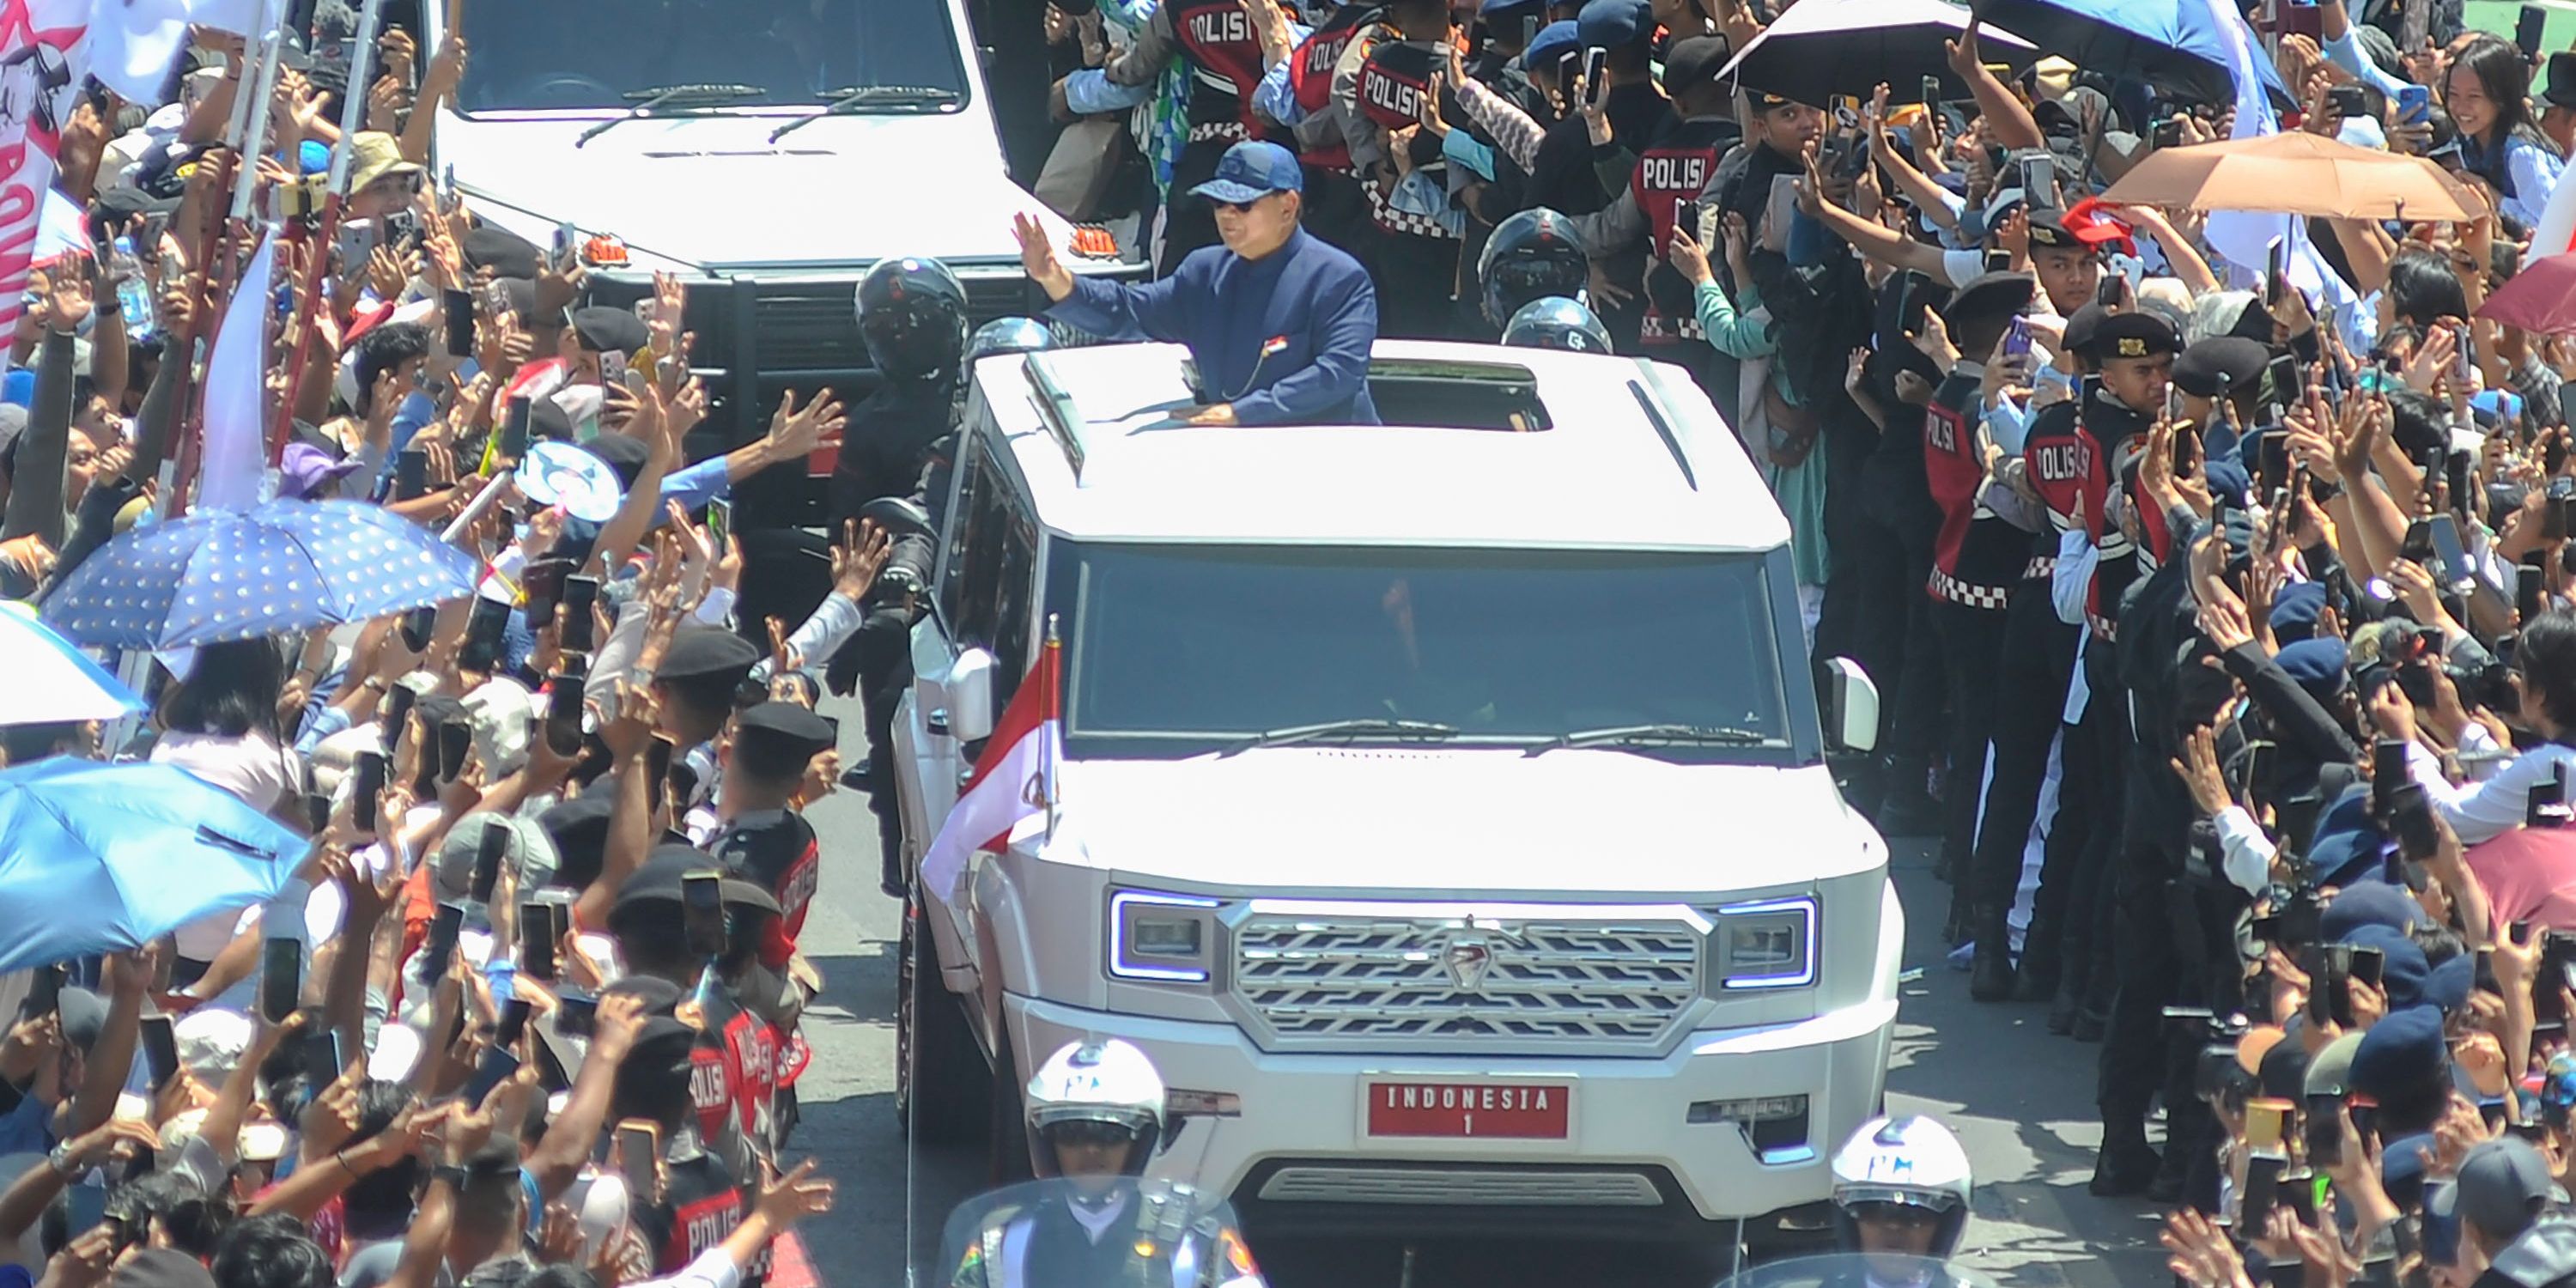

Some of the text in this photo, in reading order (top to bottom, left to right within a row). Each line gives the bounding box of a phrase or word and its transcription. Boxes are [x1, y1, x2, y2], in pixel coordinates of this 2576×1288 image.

[1364, 70, 1419, 117] POLISI
[1643, 158, 1705, 189] POLISI
[1388, 1086, 1547, 1109] INDONESIA
[1464, 1114, 1472, 1134] 1
